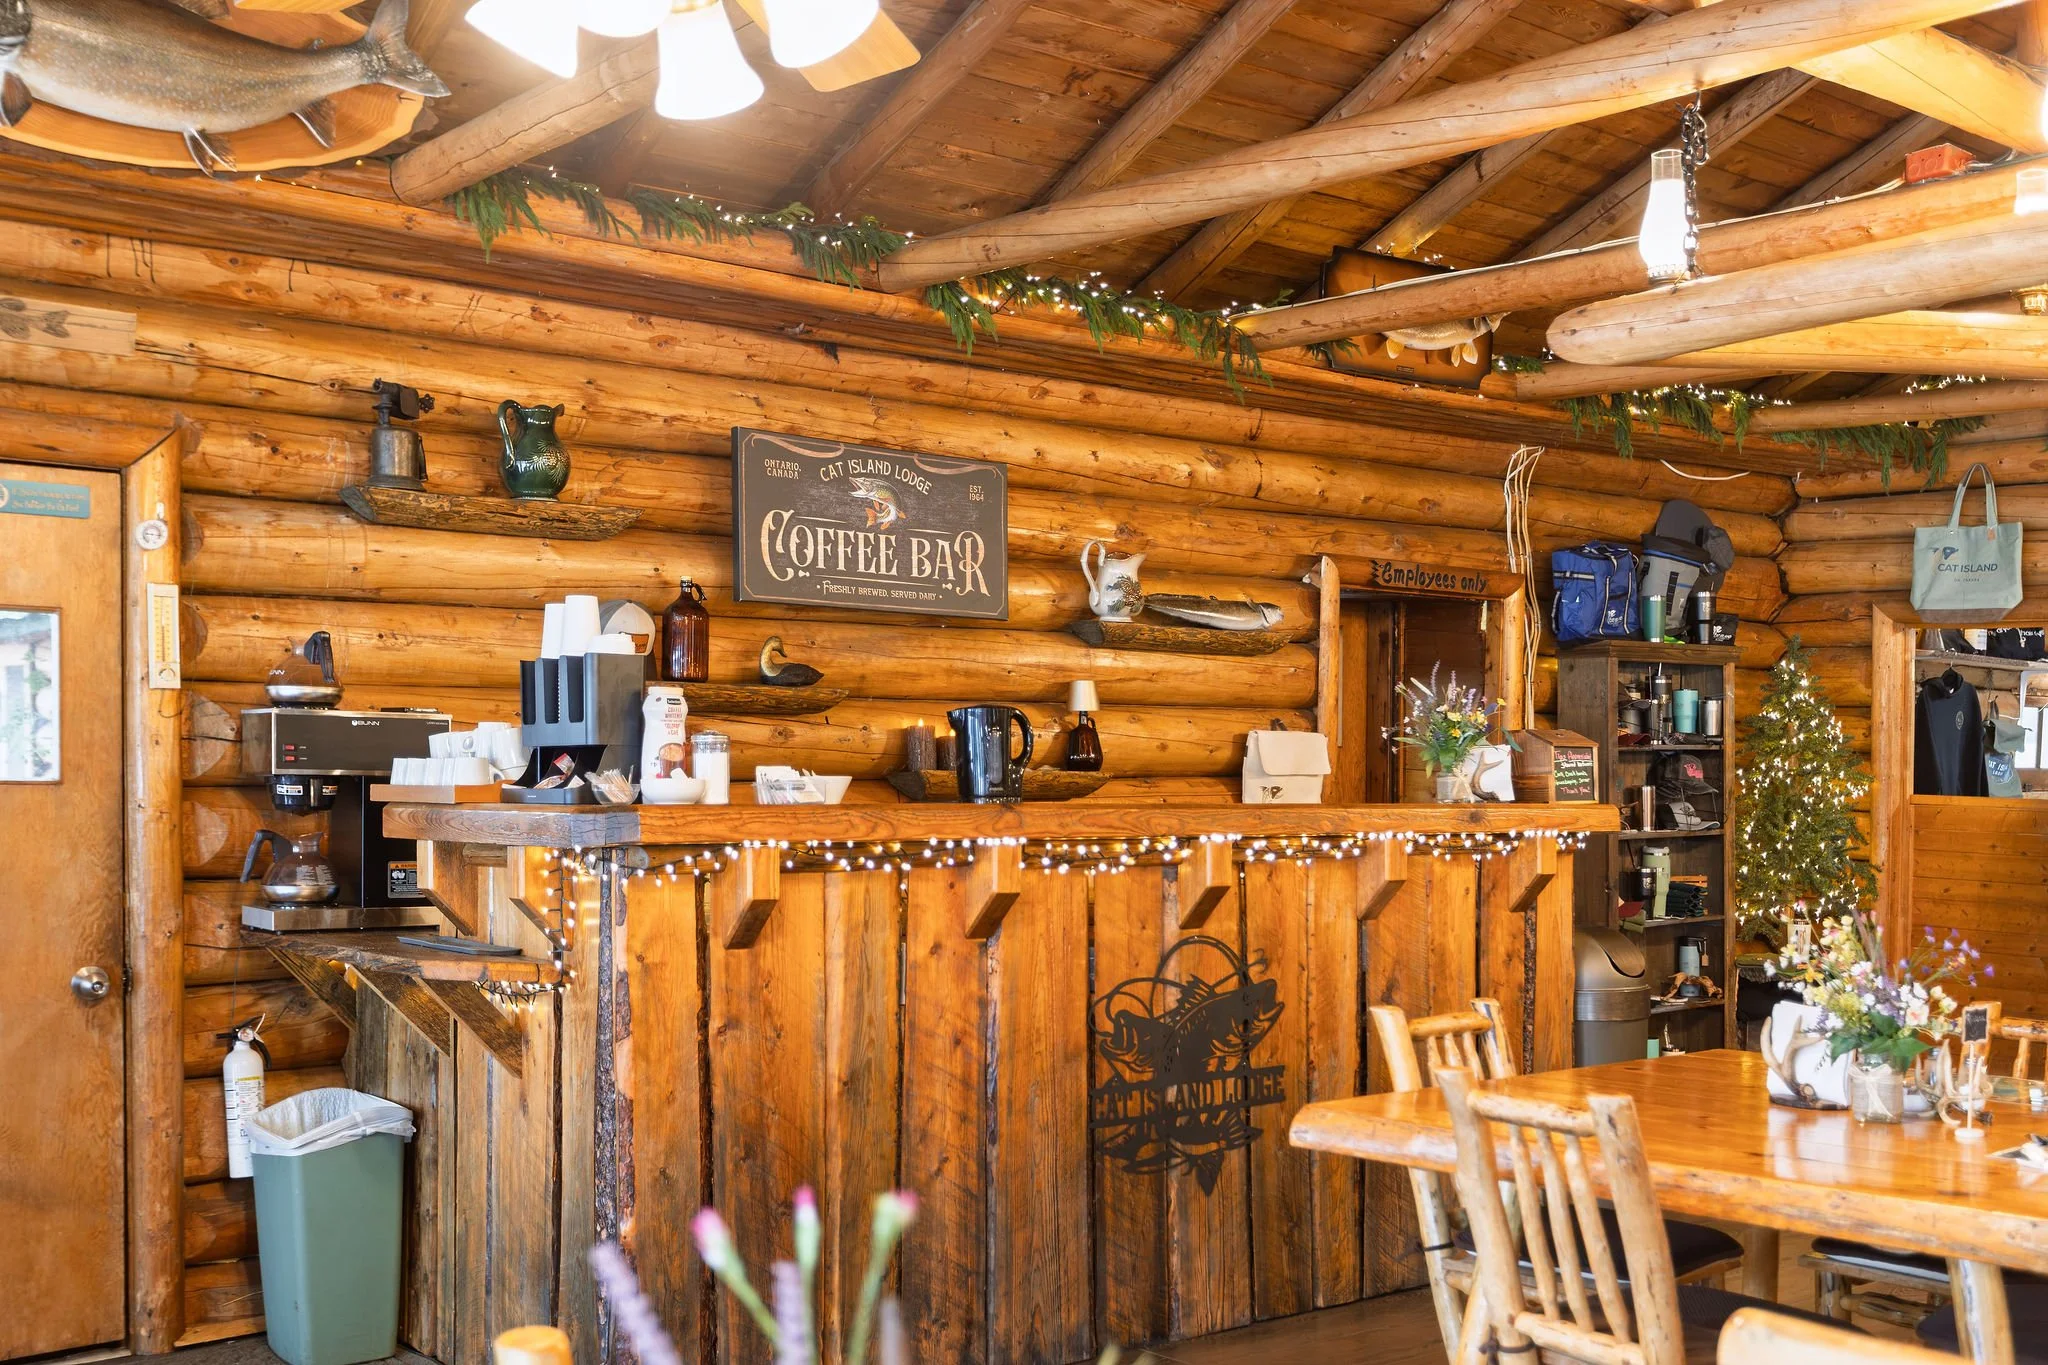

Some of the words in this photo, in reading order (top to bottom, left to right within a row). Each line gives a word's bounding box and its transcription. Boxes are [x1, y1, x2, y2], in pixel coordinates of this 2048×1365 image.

[766, 467, 799, 480] CANADA
[820, 461, 844, 482] CAT
[847, 459, 891, 476] ISLAND
[895, 468, 932, 495] LODGE
[760, 509, 898, 582] COFFEE
[909, 530, 991, 598] BAR
[1380, 561, 1457, 589] Employees
[1461, 572, 1488, 593] only
[1937, 563, 1959, 572] CAT
[1960, 563, 1998, 573] ISLAND
[822, 580, 856, 595] FRESHLY
[890, 589, 917, 600] SERVED
[918, 591, 937, 601] DAILY
